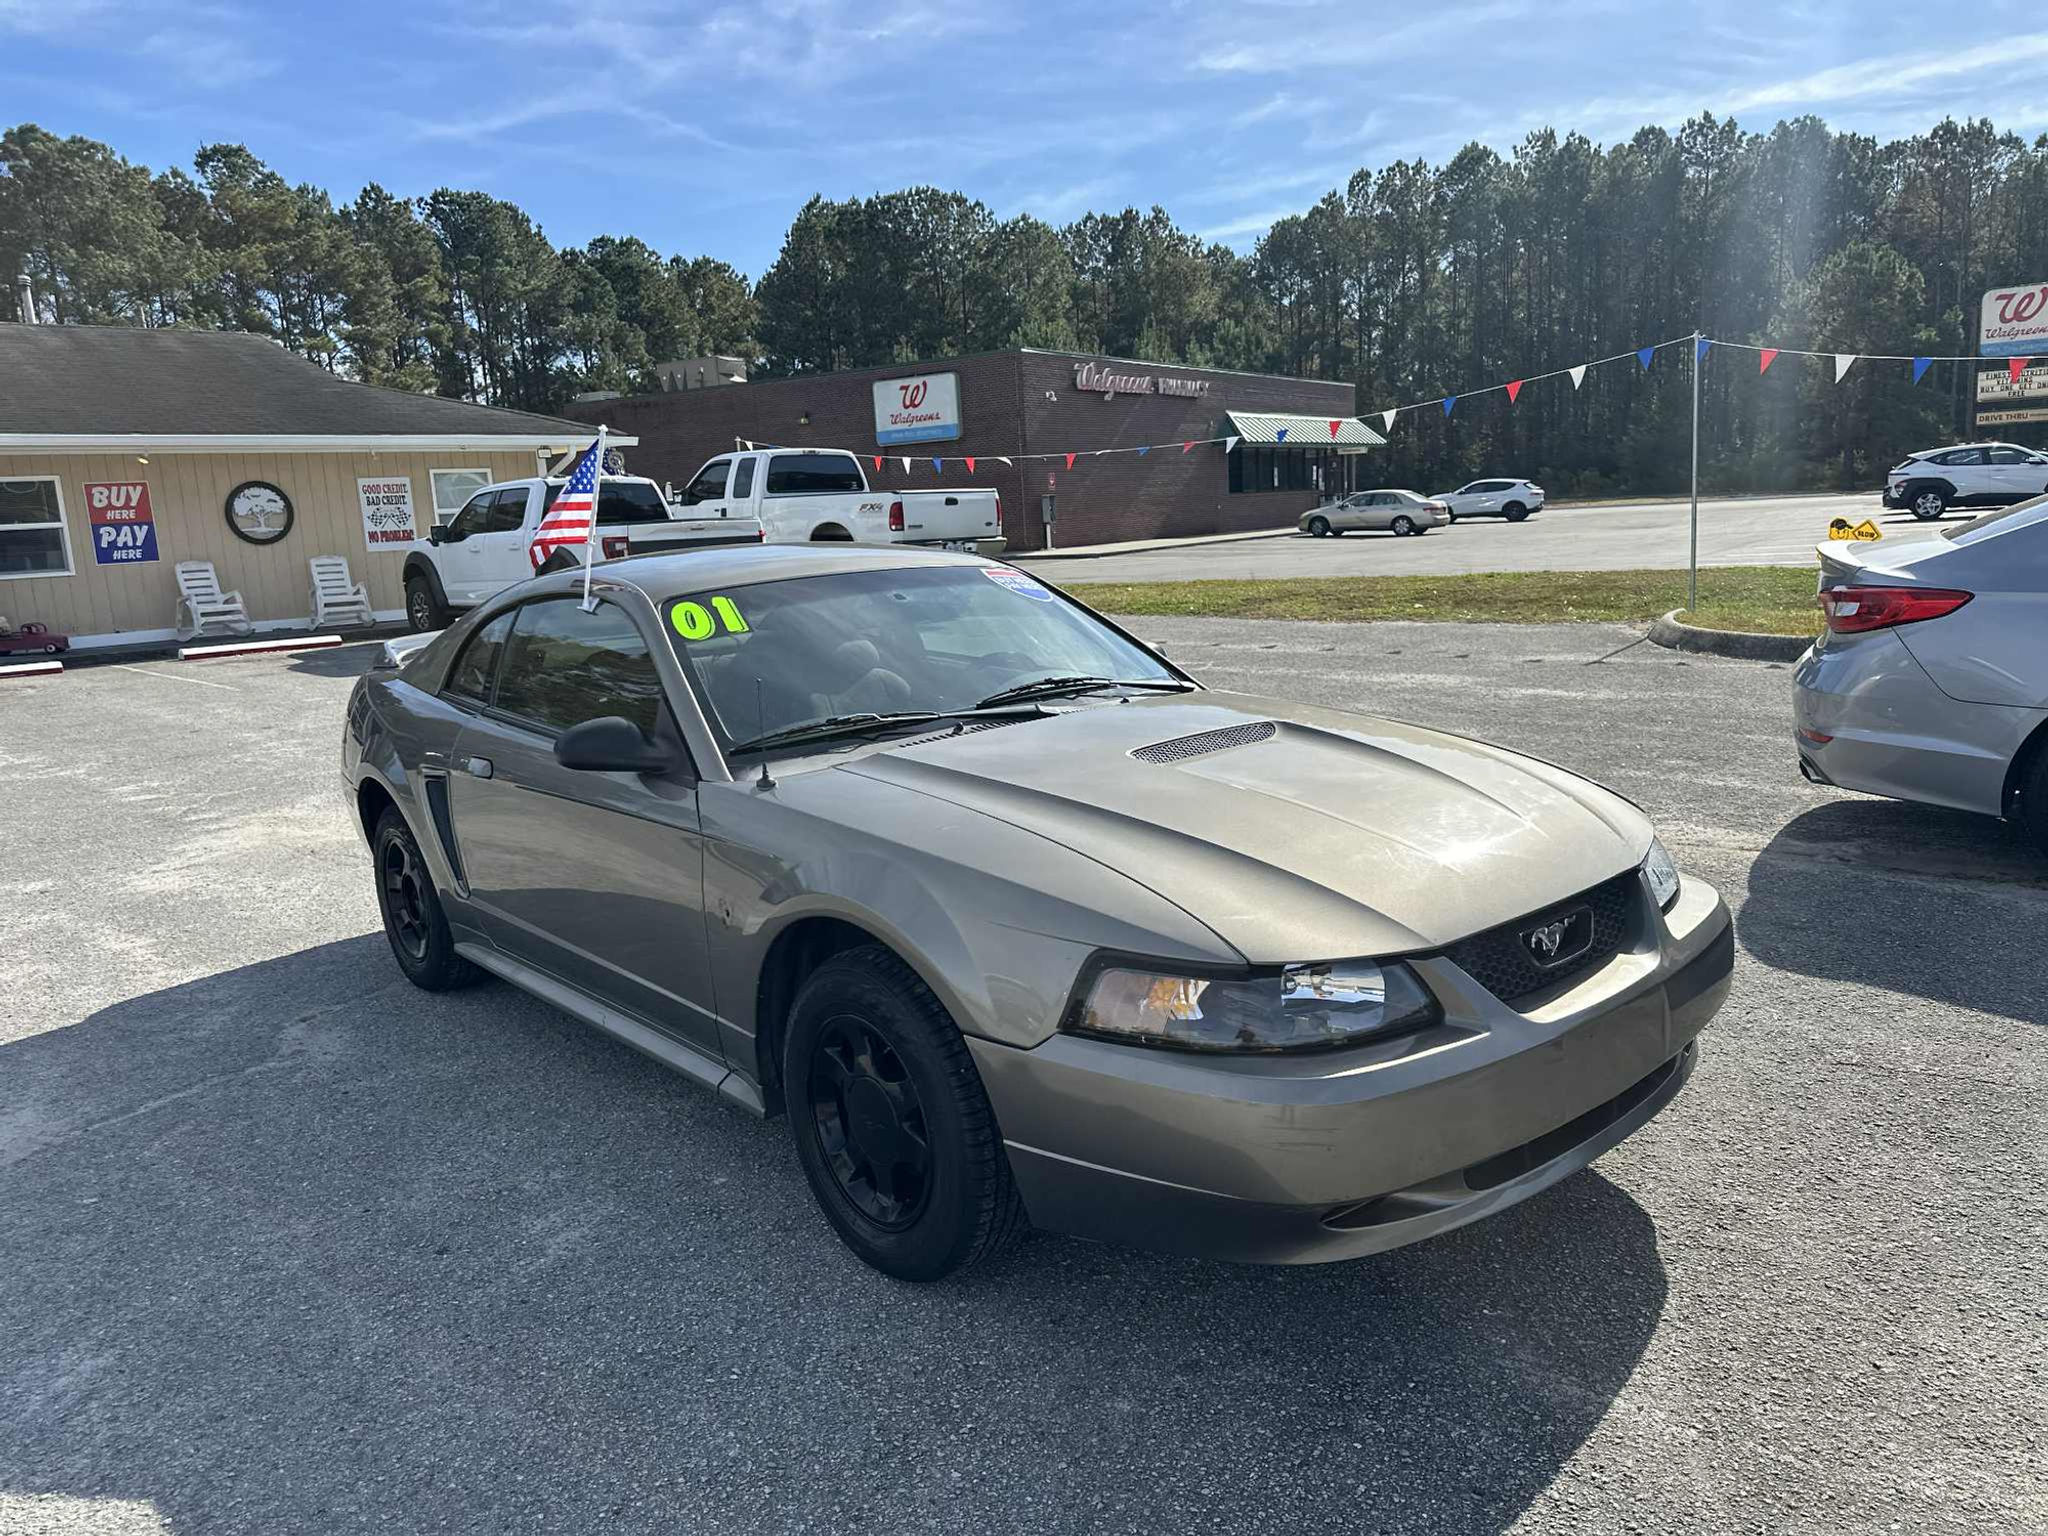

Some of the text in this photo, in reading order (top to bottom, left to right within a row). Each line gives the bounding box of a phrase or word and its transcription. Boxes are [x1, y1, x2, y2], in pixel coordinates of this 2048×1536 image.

[1995, 287, 2048, 324] W
[1985, 326, 2048, 340] Walgreen
[899, 380, 927, 409] W
[2008, 390, 2026, 398] FREE
[890, 412, 941, 427] Walgreens
[1979, 412, 2028, 422] DRIVE THRU
[362, 483, 408, 495] GOOD CREDIT
[91, 485, 143, 508] BUY
[366, 495, 407, 506] BAD CREDIT
[860, 502, 884, 512] FX4
[106, 509, 136, 520] HERE
[99, 525, 149, 548] PAY
[368, 530, 379, 543] NO
[1857, 530, 1876, 538] SLOW
[113, 549, 143, 560] HERE
[670, 596, 749, 641] 01
